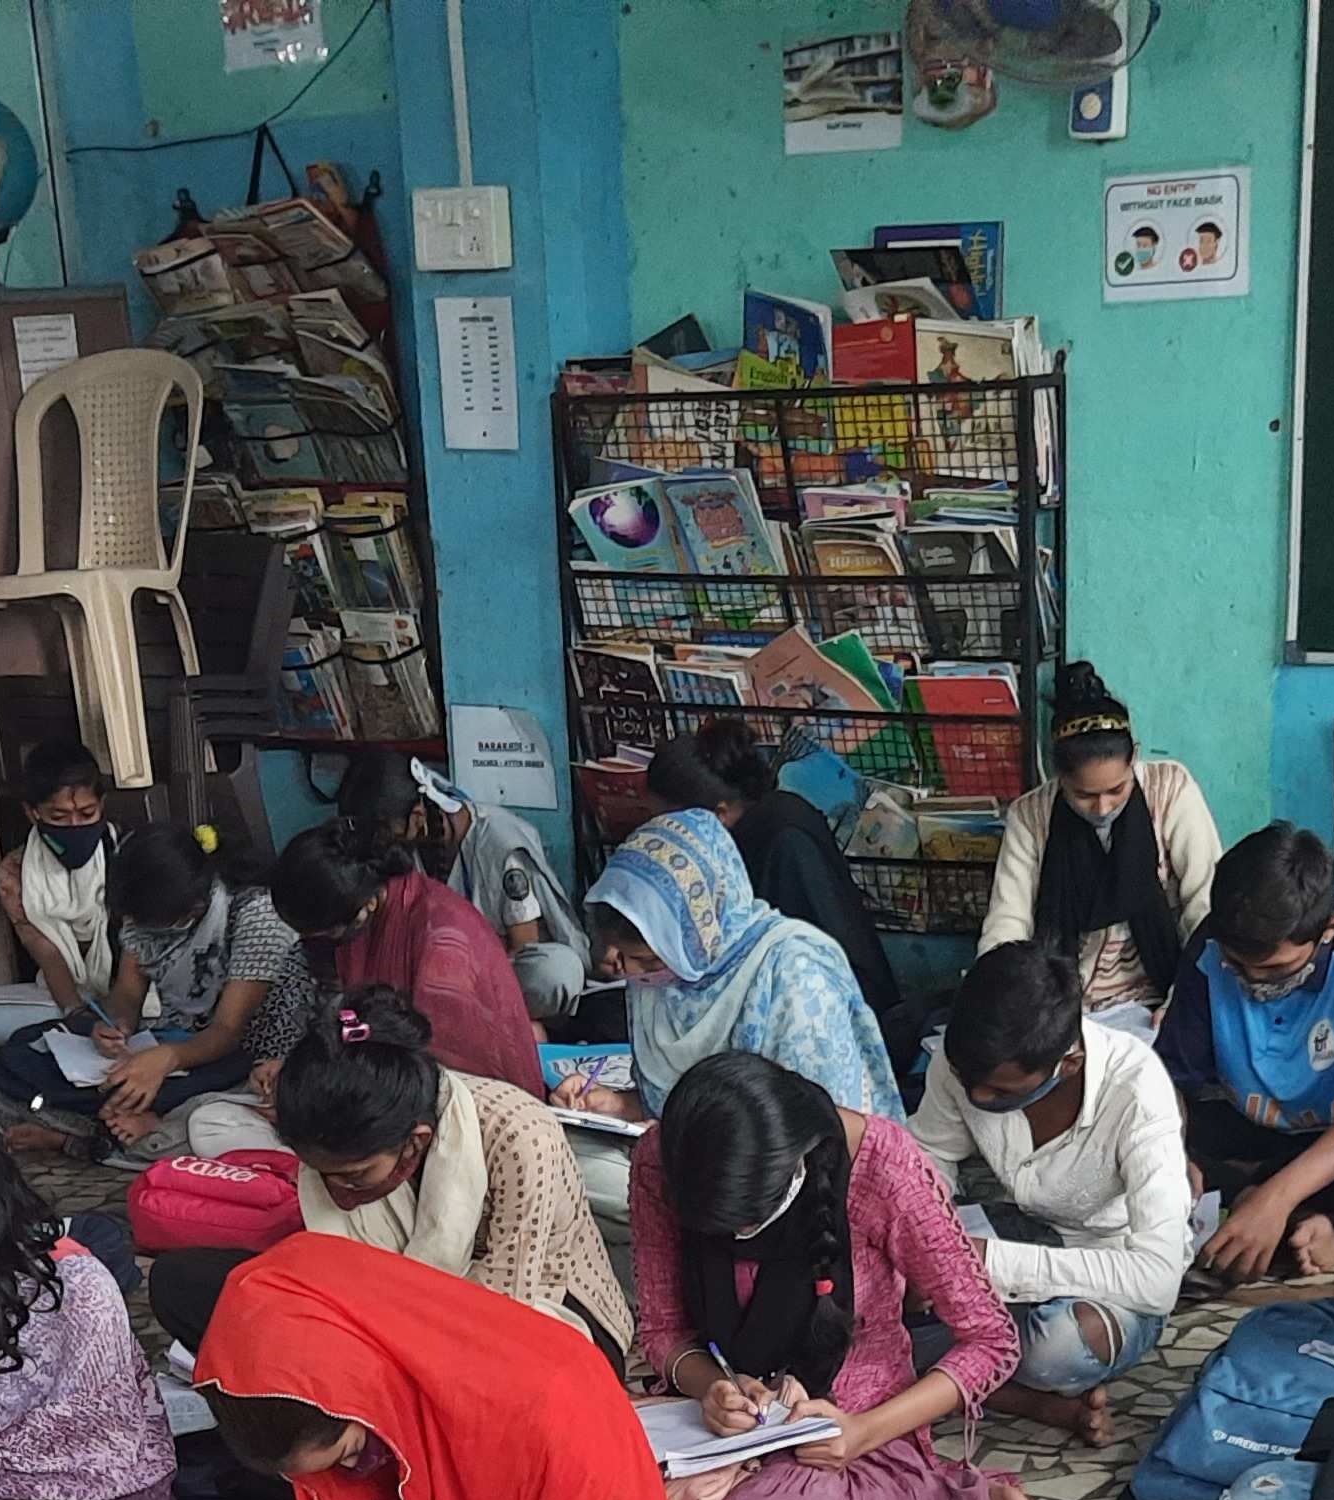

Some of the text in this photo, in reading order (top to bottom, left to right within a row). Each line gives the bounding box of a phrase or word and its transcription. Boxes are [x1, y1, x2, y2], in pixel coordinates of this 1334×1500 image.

[1147, 183, 1197, 196] NO ENTRY
[1120, 195, 1223, 212] WITHOUT FACE MASK
